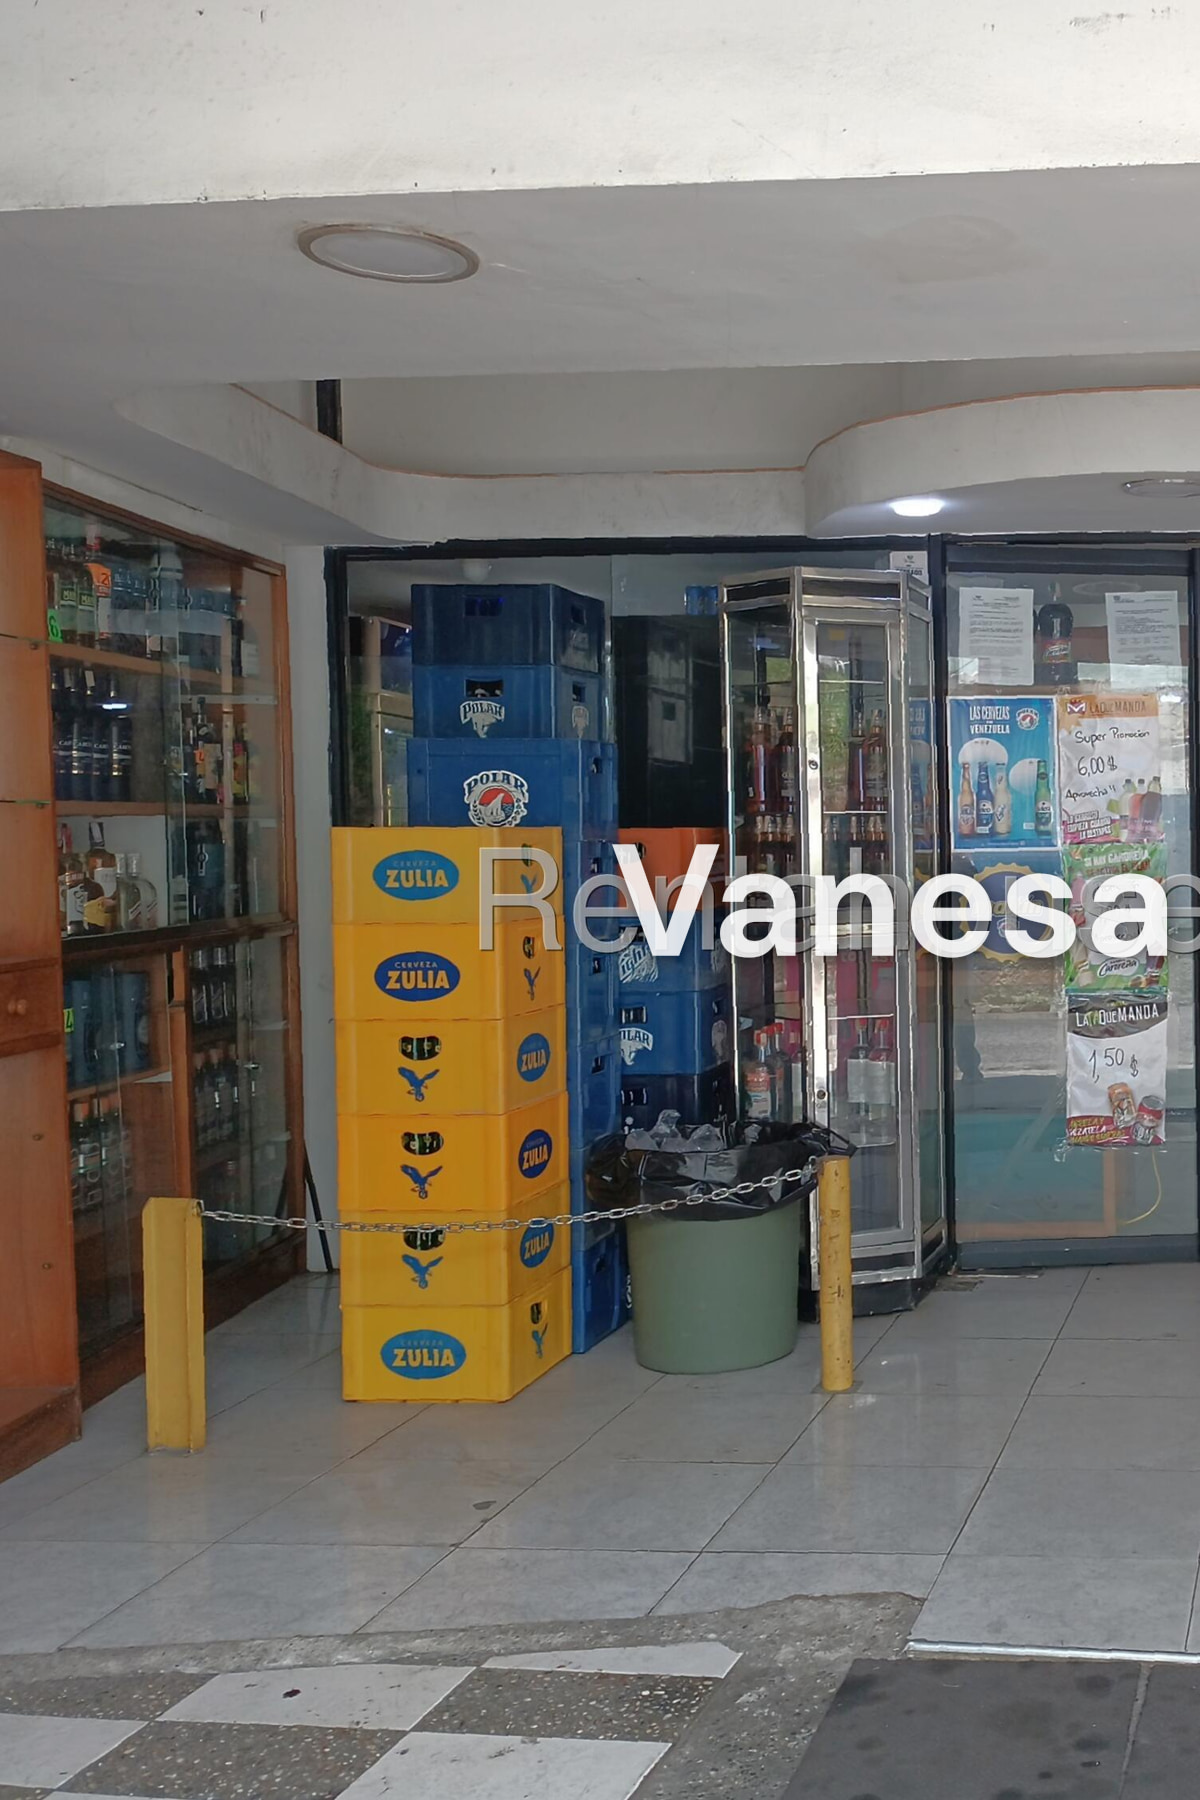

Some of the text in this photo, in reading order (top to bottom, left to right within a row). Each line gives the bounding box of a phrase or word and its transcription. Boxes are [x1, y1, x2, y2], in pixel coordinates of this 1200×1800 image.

[462, 702, 504, 719] POLAR
[969, 705, 1010, 721] LAS CERVEZAS
[970, 724, 1010, 734] VENEZUELA
[1074, 730, 1107, 747] Super
[466, 771, 527, 795] POLAR
[385, 869, 449, 889] ZULIA
[385, 970, 450, 990] ZULIA
[521, 1049, 547, 1073] ZULIA
[522, 1144, 549, 1171] ZULIA
[524, 1231, 550, 1260] ZULIA
[392, 1348, 456, 1368] ZULIA
